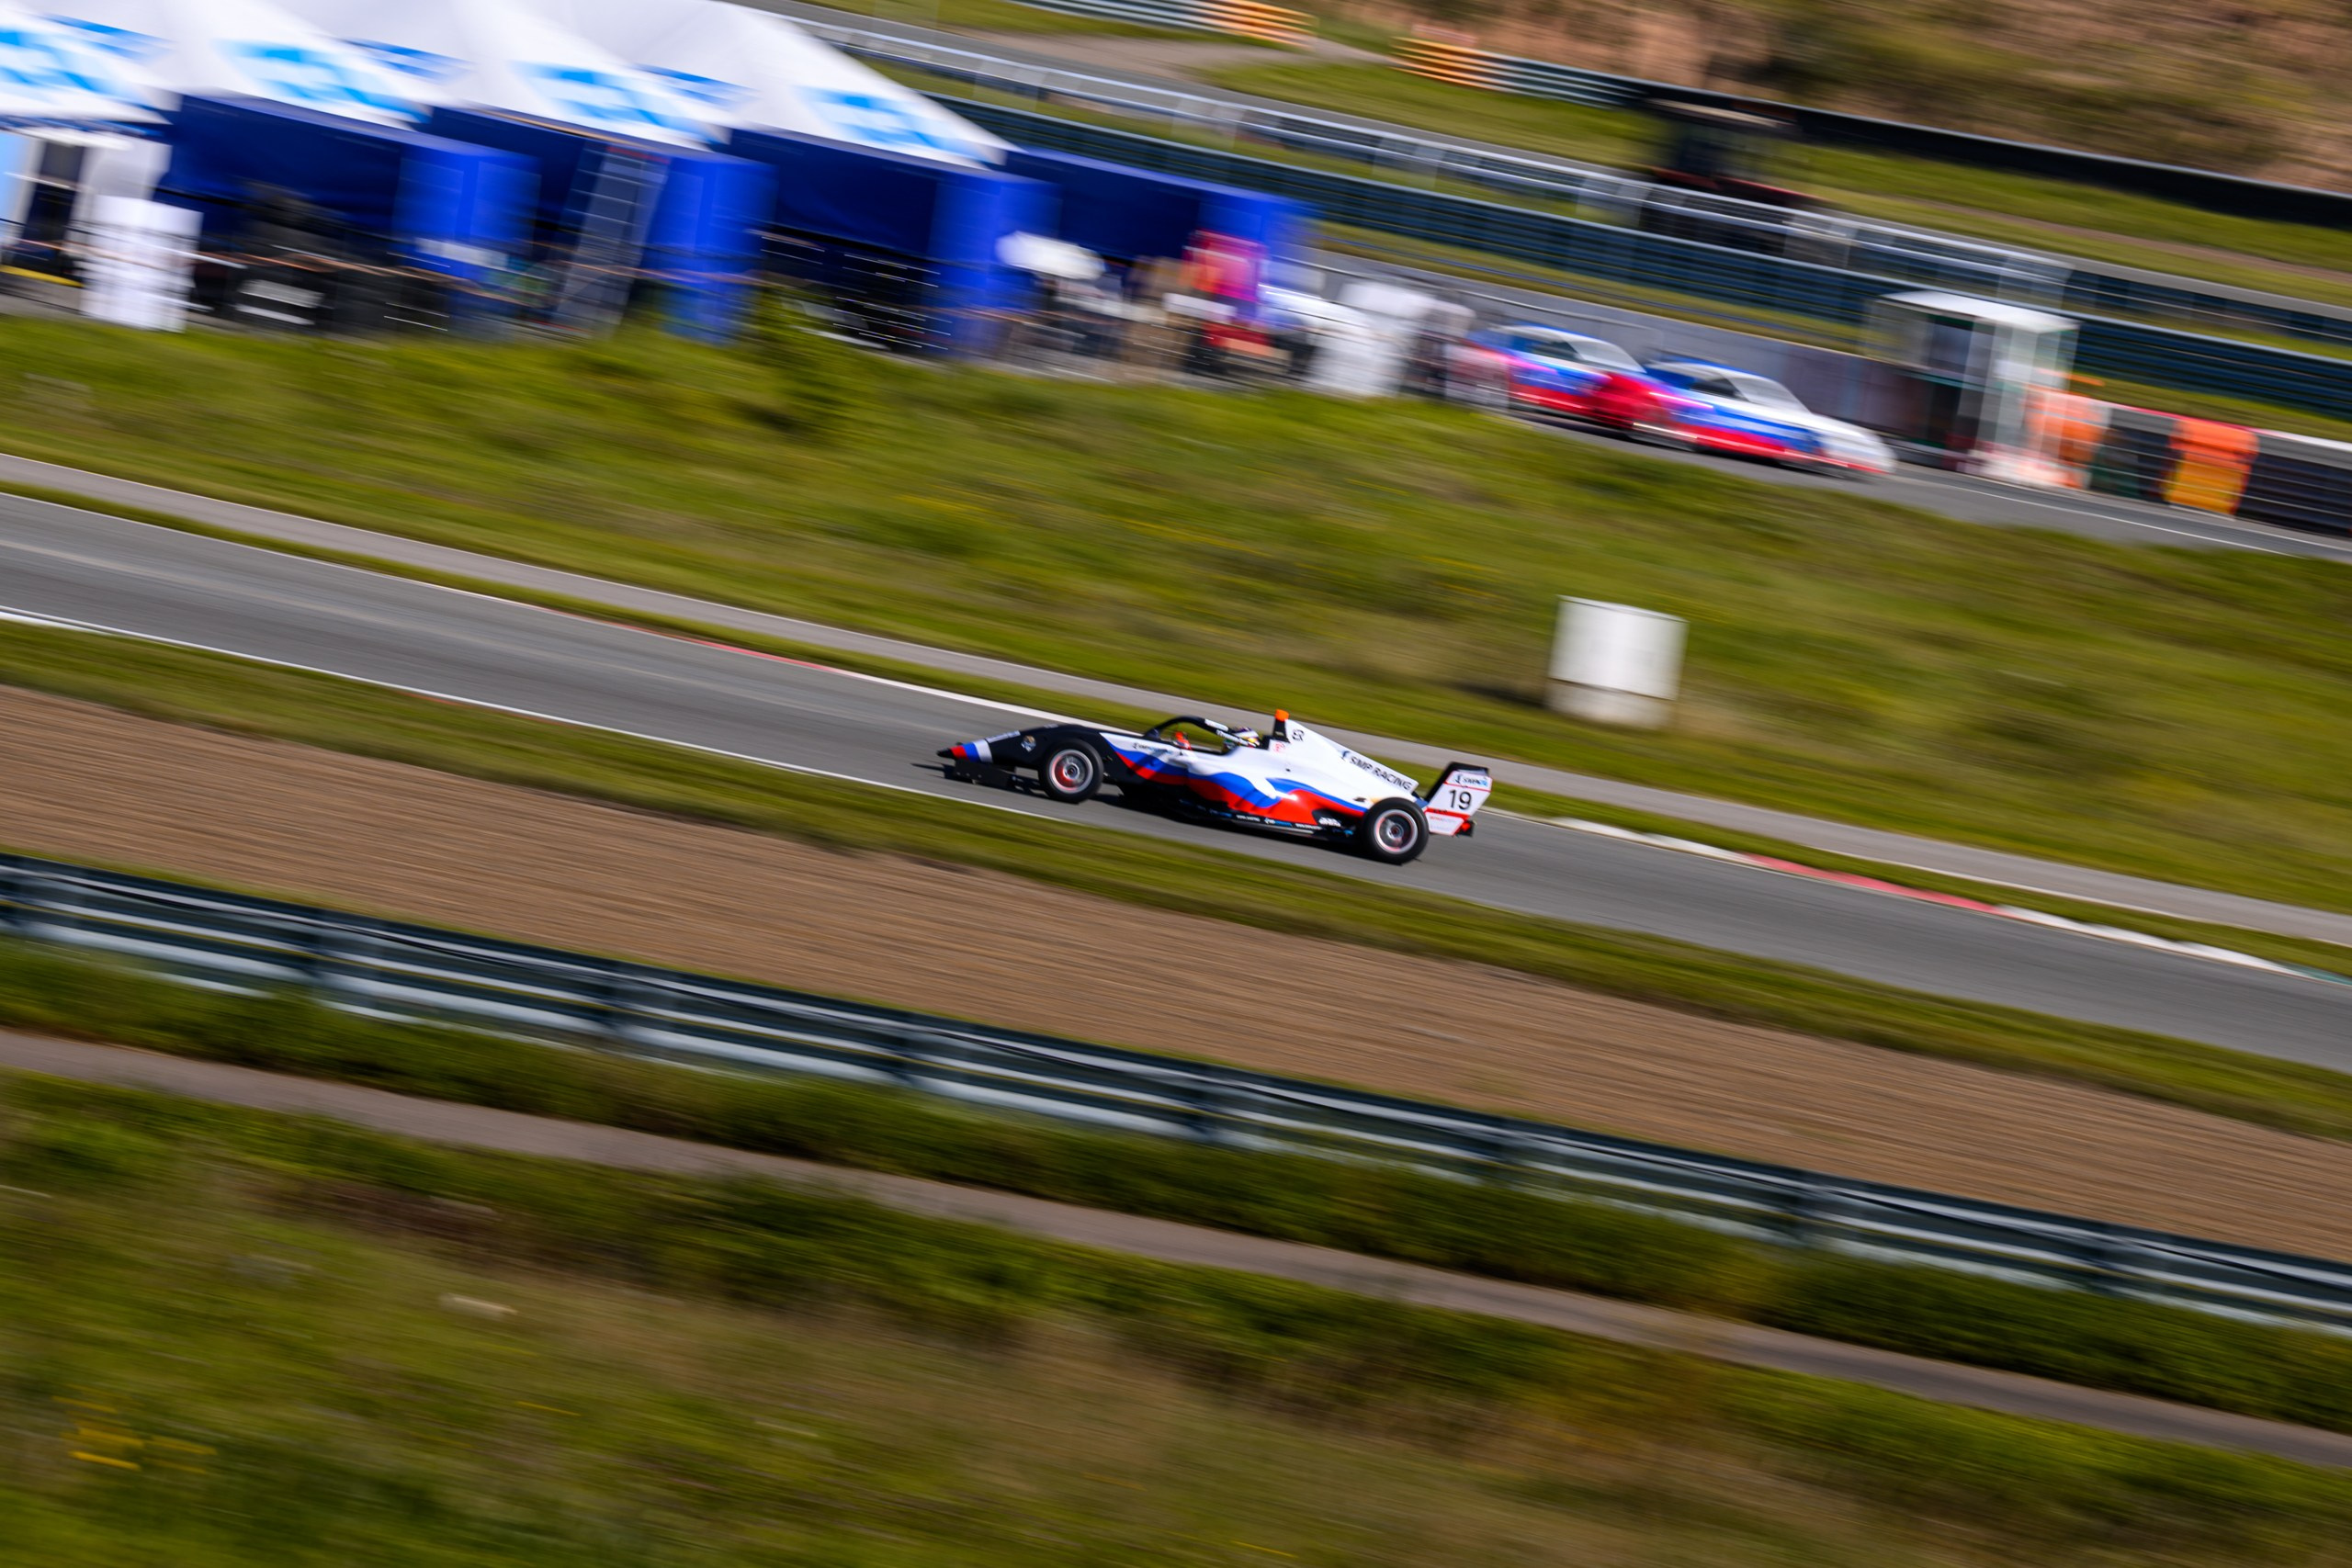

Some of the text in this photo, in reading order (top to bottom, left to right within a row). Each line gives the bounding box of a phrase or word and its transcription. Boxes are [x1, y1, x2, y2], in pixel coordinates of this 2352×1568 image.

[1350, 756, 1412, 791] SMP RACING
[1449, 789, 1472, 810] 19
